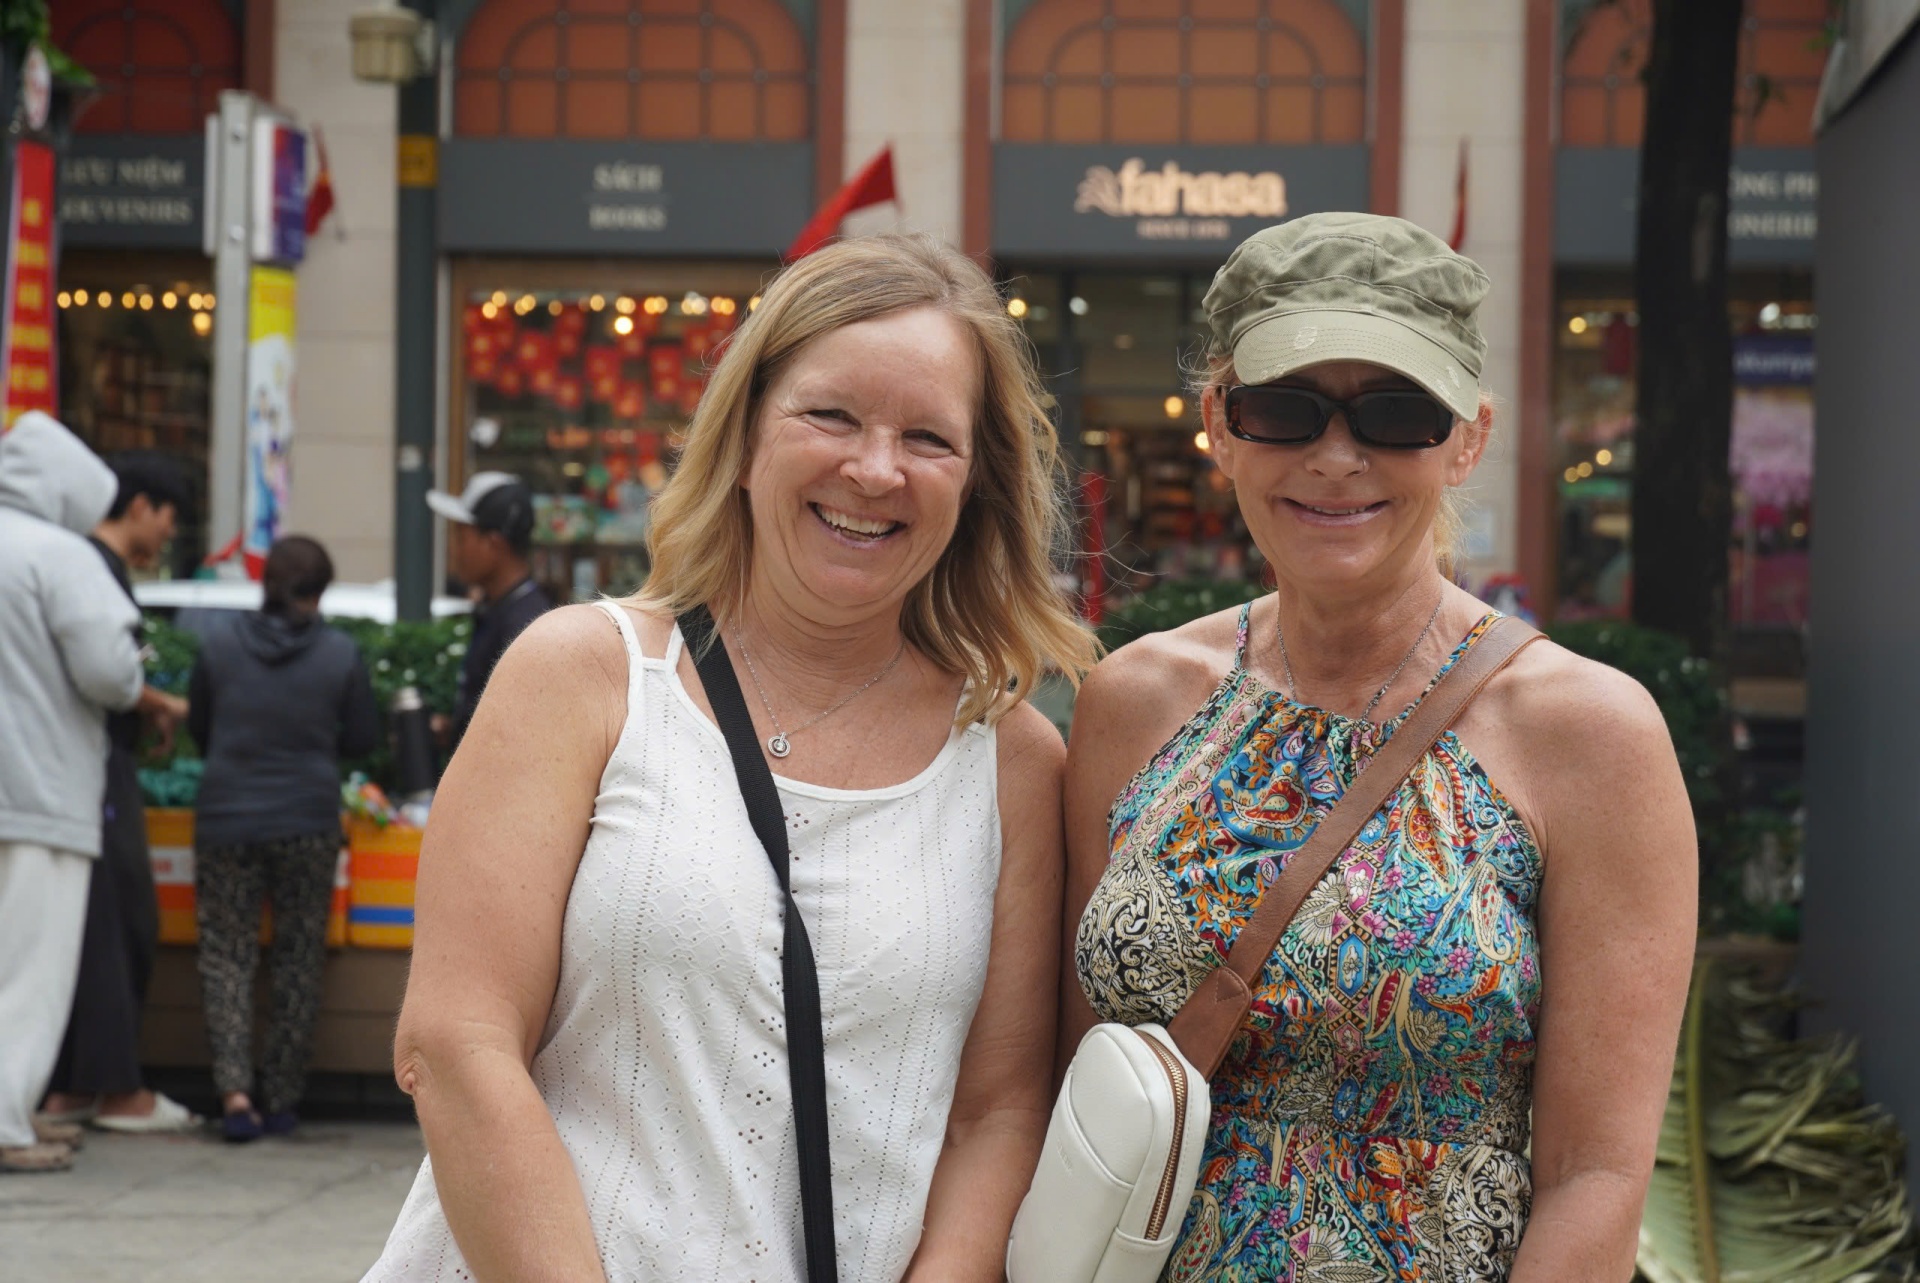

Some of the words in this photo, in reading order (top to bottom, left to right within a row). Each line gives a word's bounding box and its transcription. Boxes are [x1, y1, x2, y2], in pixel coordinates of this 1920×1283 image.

[593, 160, 663, 191] SÁCH
[1118, 157, 1288, 217] fahasa
[589, 205, 666, 230] BOOKS
